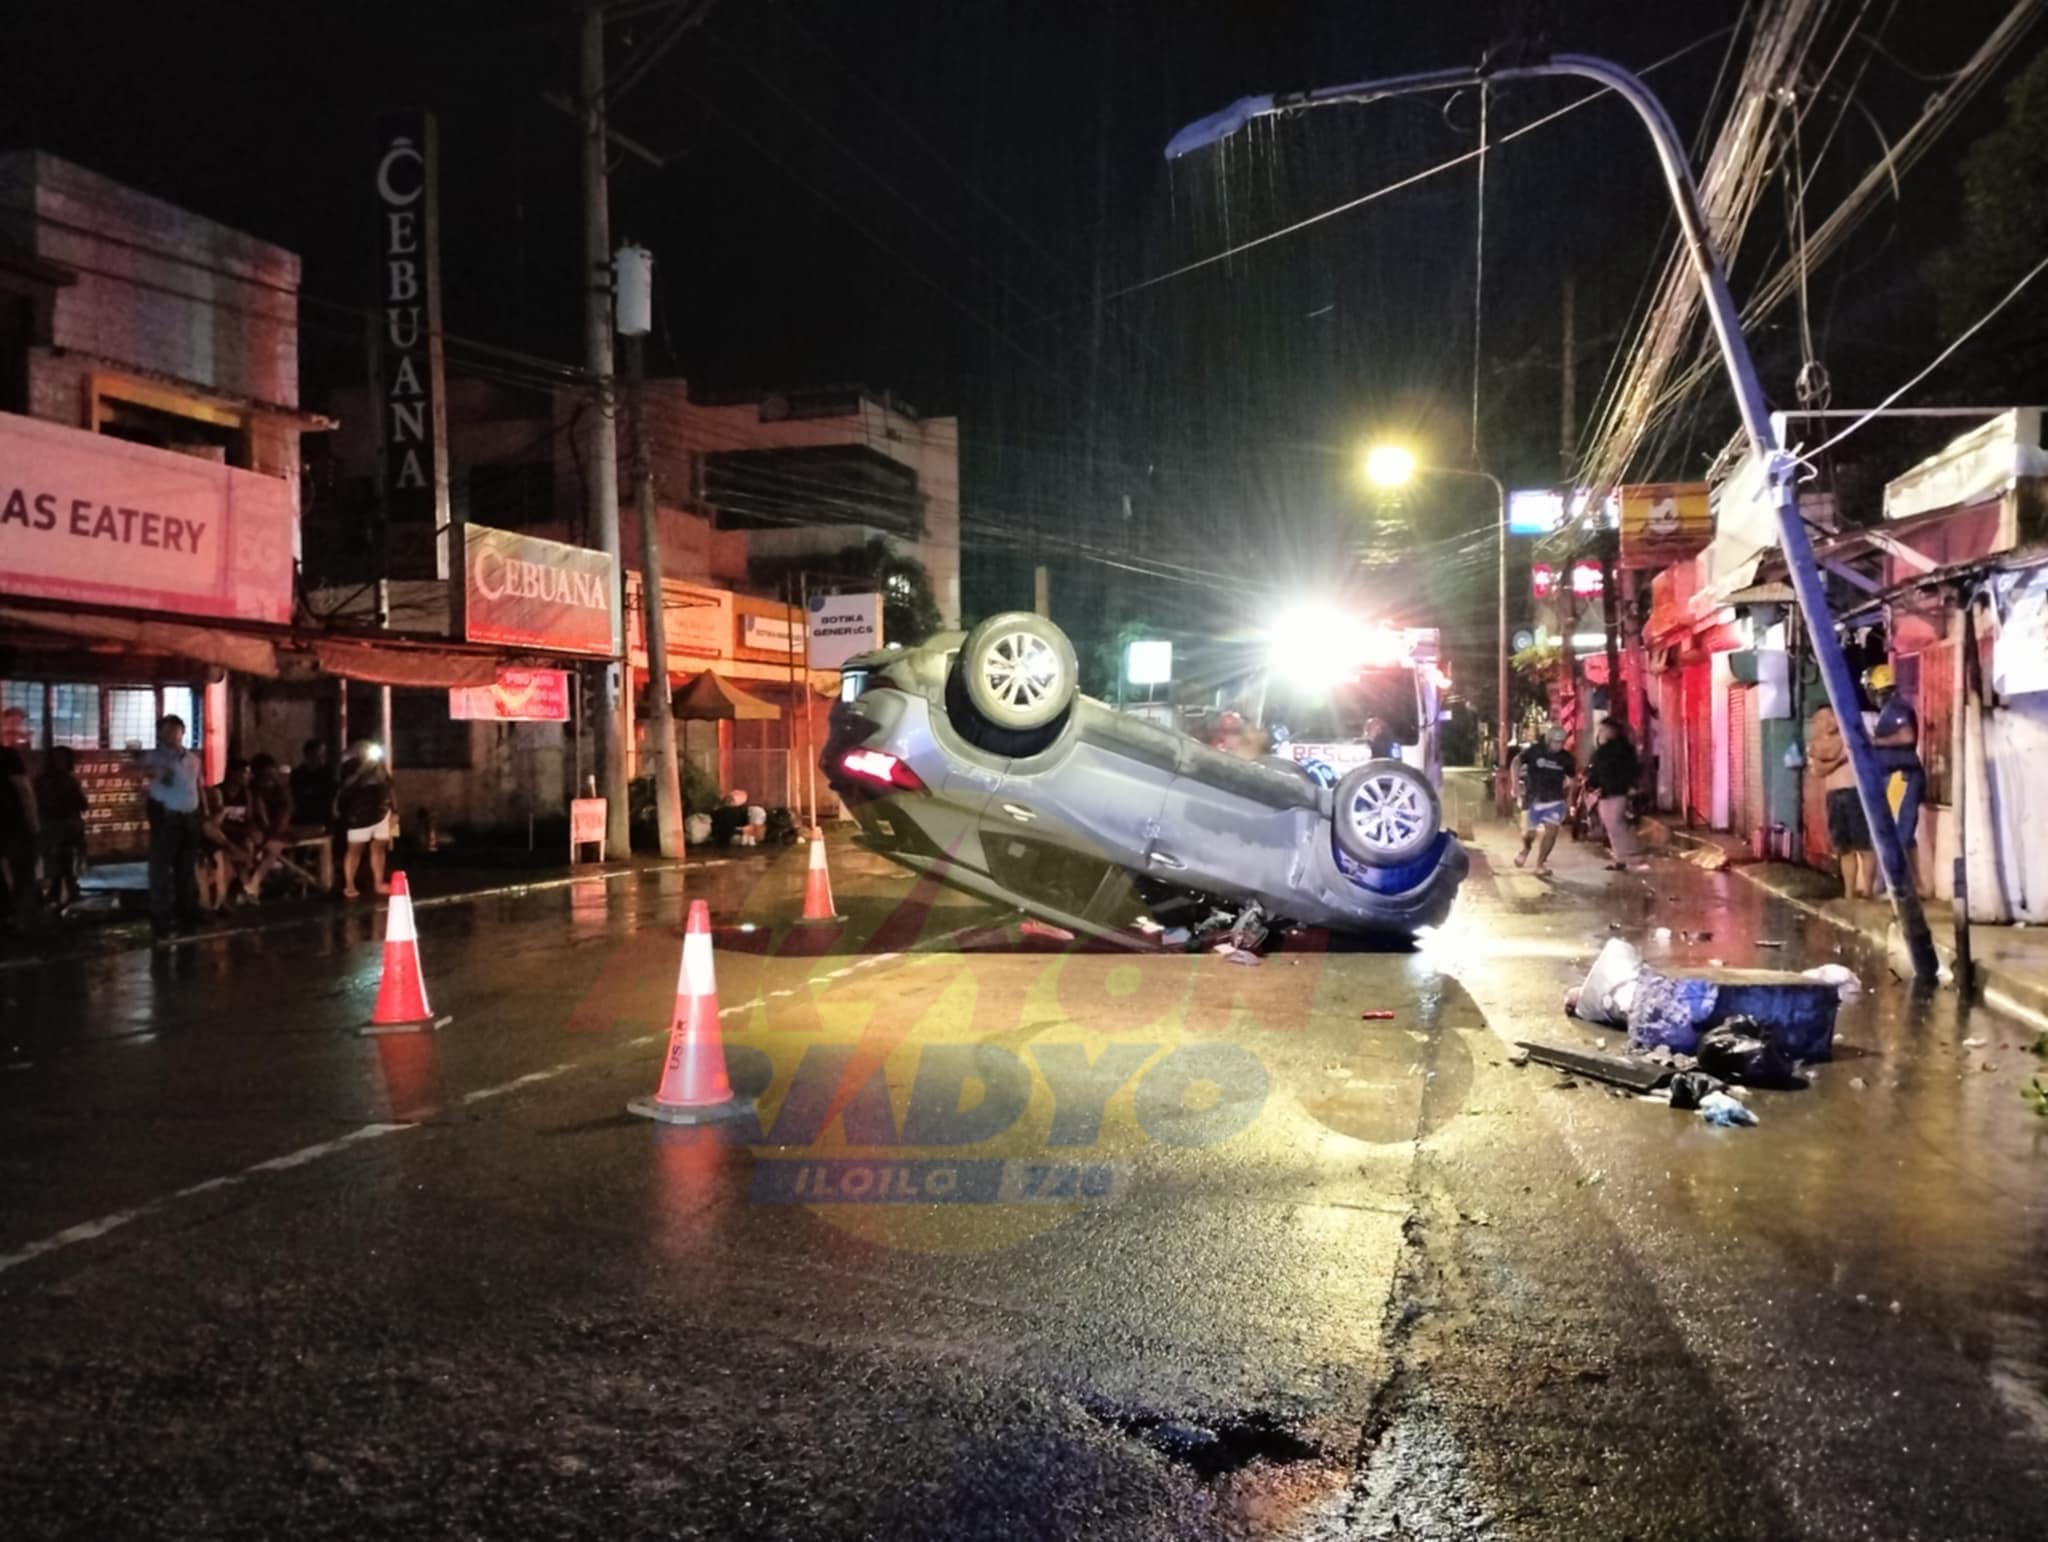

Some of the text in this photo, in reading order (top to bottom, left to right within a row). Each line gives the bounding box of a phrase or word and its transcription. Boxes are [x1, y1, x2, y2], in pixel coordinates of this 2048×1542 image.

[376, 142, 428, 489] CEBUANA
[1, 488, 206, 554] AS EATERY
[474, 545, 608, 610] CEBUANA
[821, 614, 864, 624] BOTIKA
